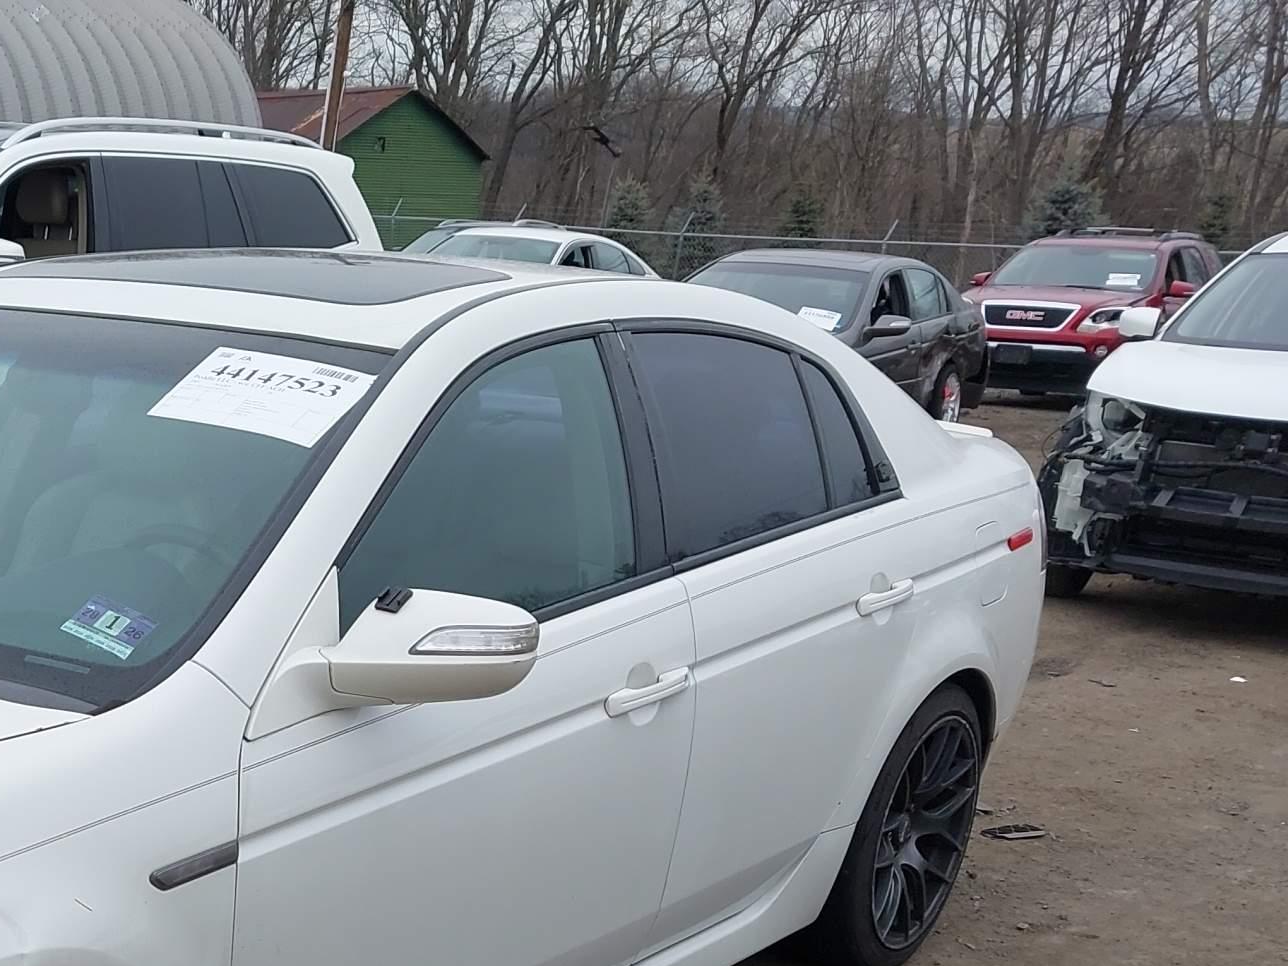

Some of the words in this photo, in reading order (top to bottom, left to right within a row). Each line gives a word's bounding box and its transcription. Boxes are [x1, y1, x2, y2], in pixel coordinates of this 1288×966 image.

[1005, 309, 1045, 321] GMC
[211, 364, 342, 398] 44147523
[105, 615, 121, 630] 1
[124, 626, 144, 640] 26
